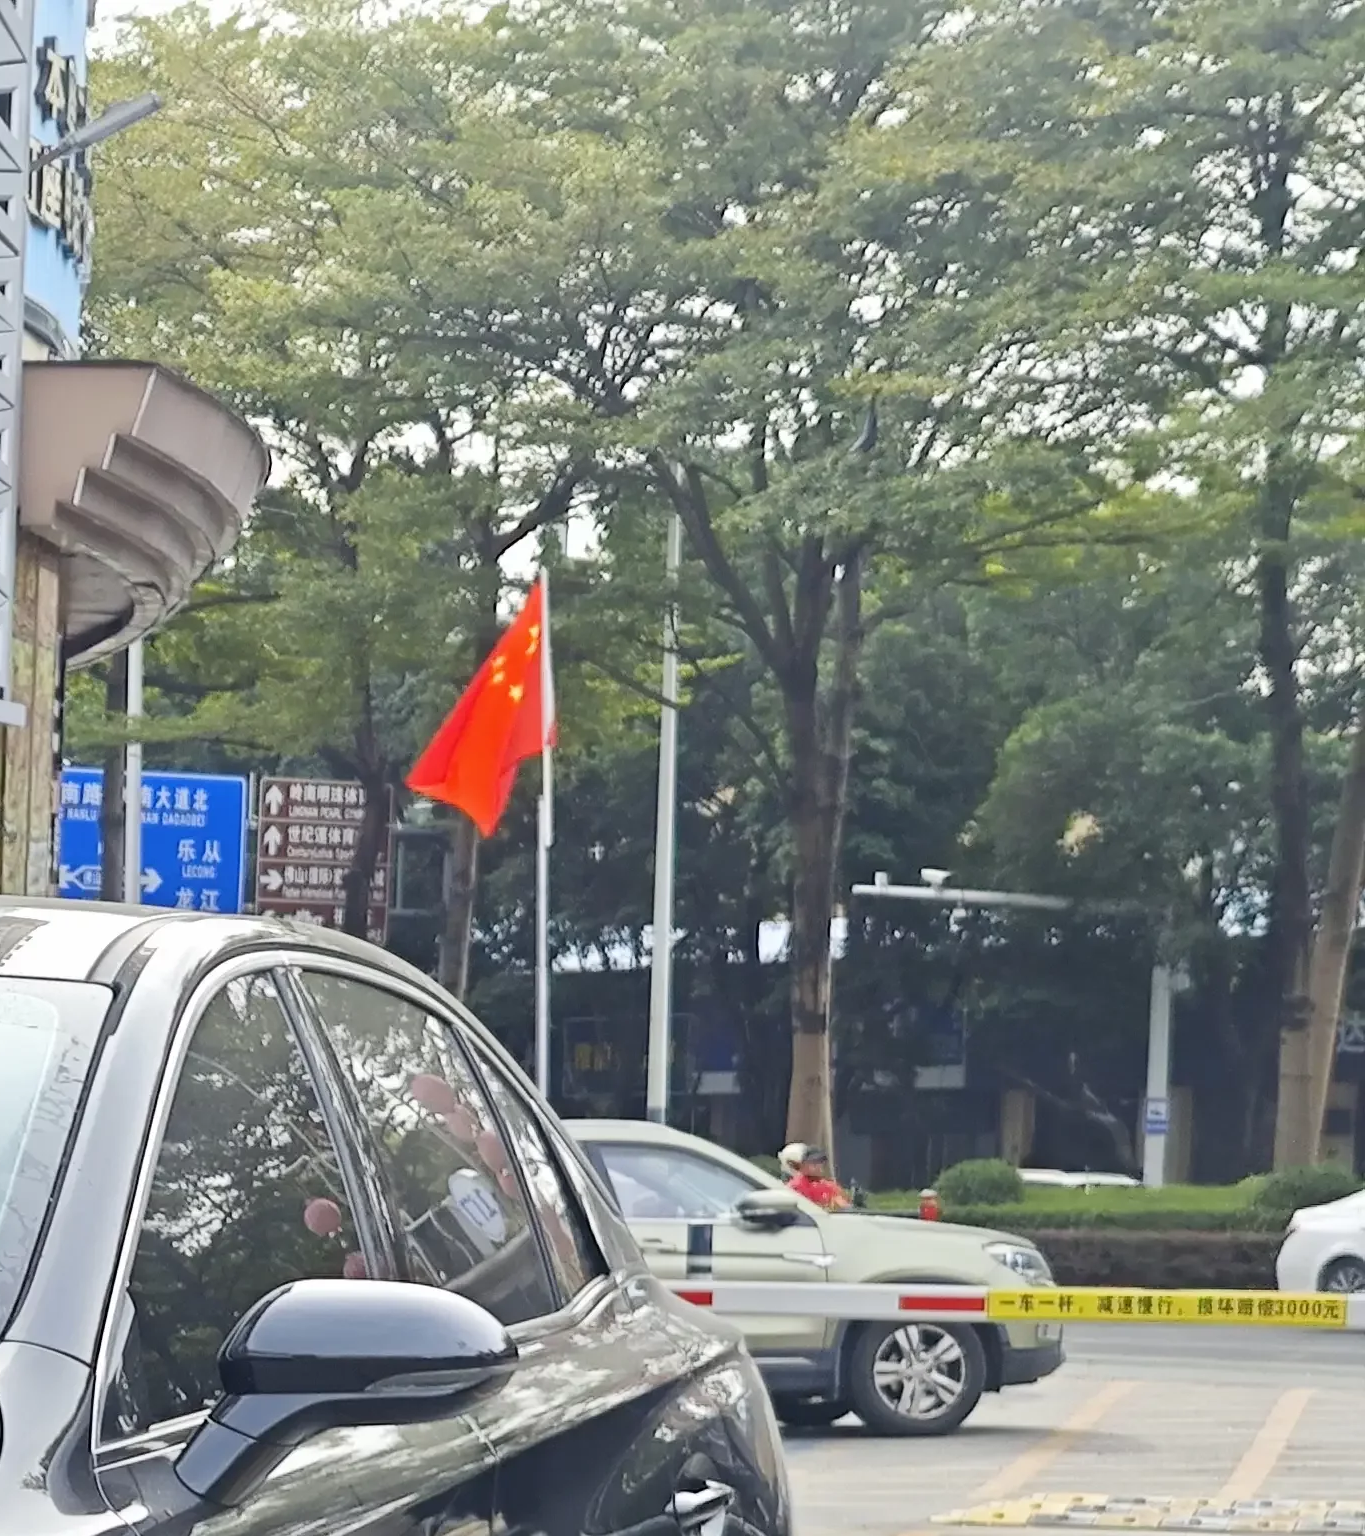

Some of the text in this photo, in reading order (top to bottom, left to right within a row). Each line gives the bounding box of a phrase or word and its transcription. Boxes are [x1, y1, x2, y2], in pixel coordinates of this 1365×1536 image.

[123, 784, 209, 812] 南大道北
[287, 825, 360, 846] 世纪莲体育
[177, 839, 221, 863] 乐从
